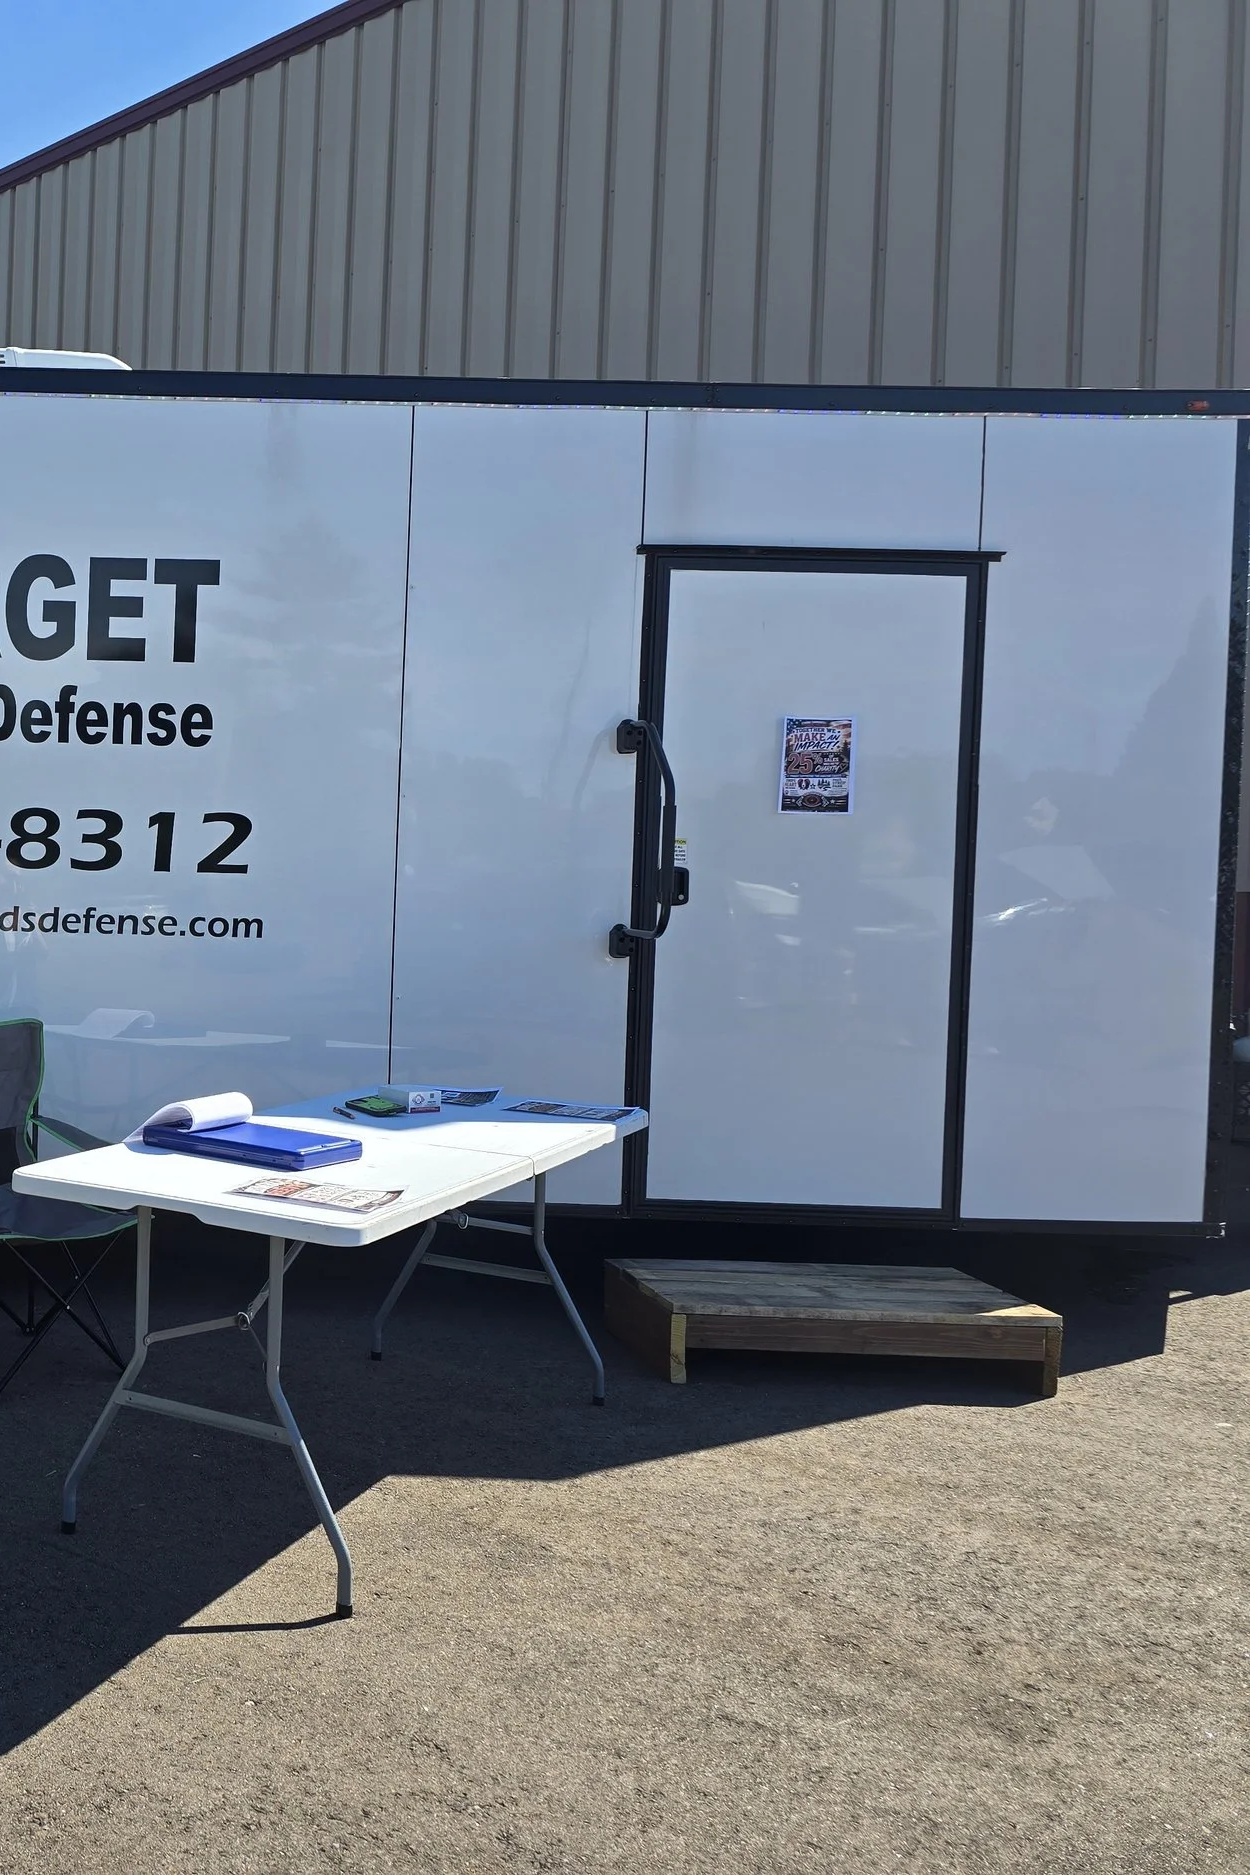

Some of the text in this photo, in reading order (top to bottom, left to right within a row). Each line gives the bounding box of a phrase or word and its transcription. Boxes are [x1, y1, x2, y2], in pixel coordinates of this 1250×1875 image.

[794, 733, 826, 742] MAKE
[794, 741, 840, 751] IMPACT!
[787, 752, 823, 774] 25%
